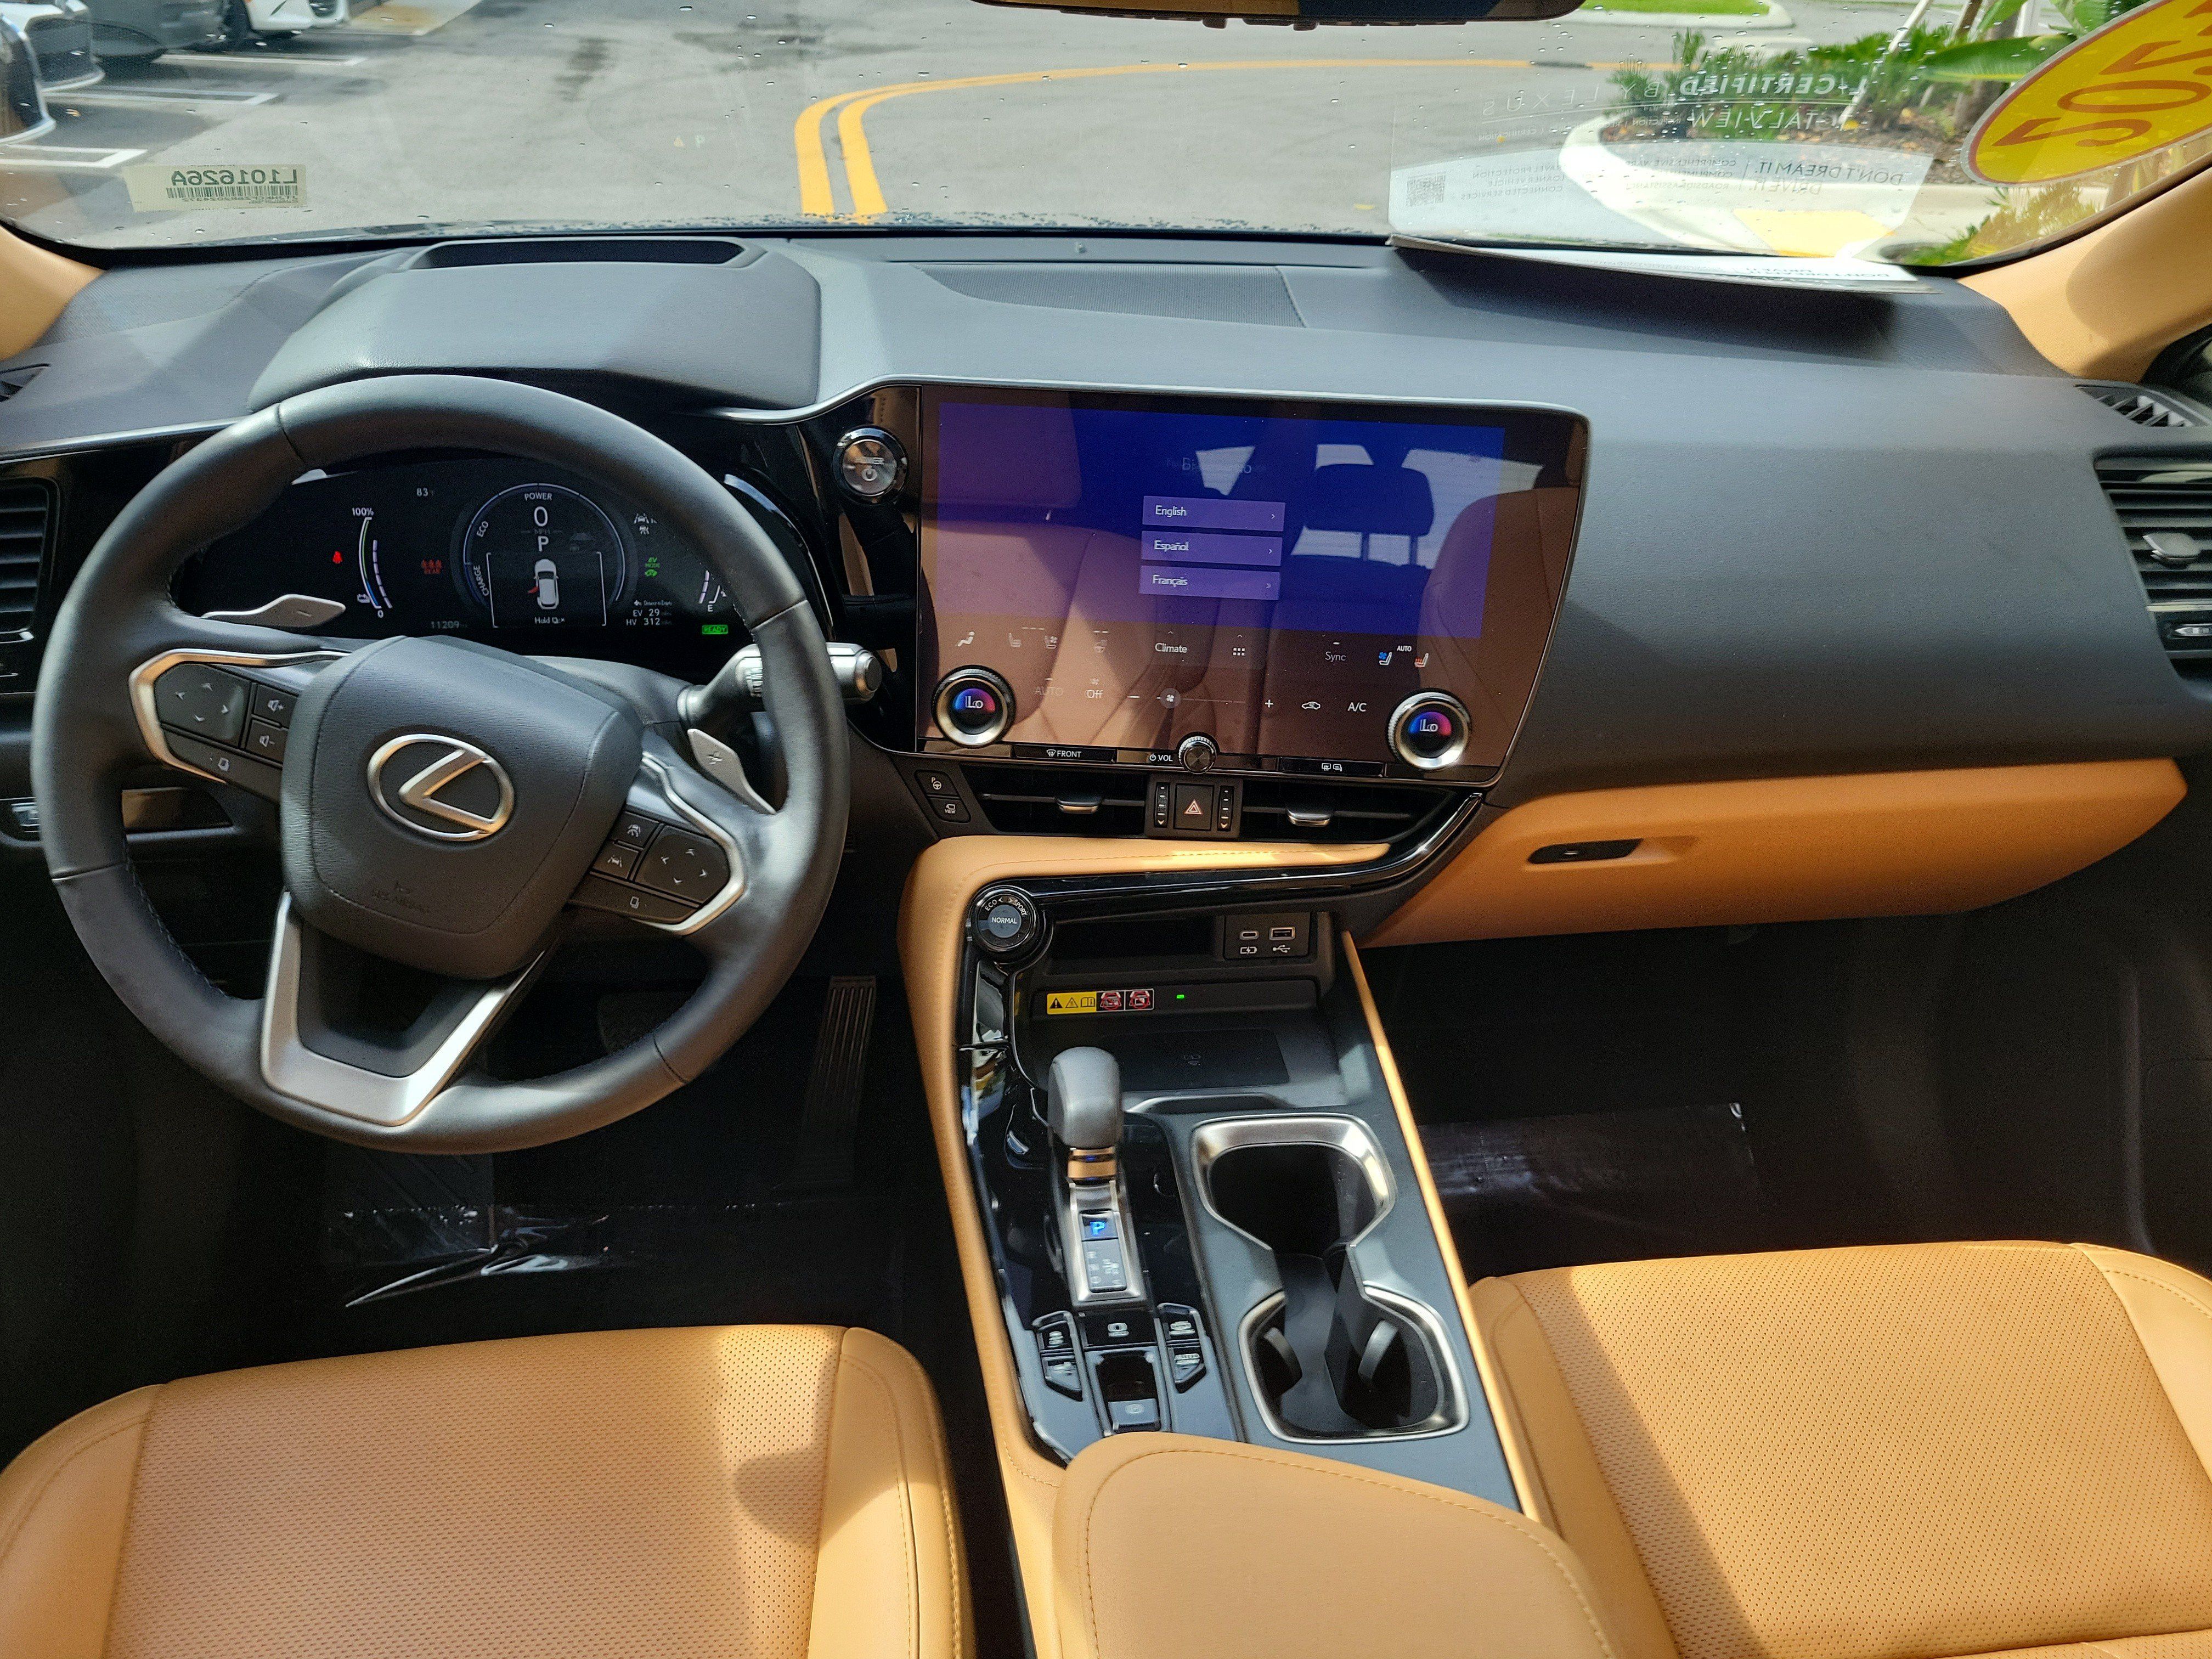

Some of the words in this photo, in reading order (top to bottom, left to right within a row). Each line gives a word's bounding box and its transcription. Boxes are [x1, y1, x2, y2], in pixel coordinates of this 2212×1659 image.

[524, 492, 552, 501] POWER
[352, 507, 374, 517] 100%
[534, 506, 548, 527] 0
[1155, 505, 1187, 517] English
[476, 521, 489, 538] ECO
[538, 535, 549, 552] P
[1154, 539, 1189, 552] Español
[472, 564, 489, 597] CHARGE
[1152, 574, 1188, 587] Français
[633, 609, 643, 617] EV
[648, 608, 660, 617] 29
[626, 618, 637, 627] HV
[644, 618, 661, 626] 312
[1155, 642, 1188, 653] Climate
[1324, 651, 1346, 662] Sync
[1086, 689, 1104, 699] Off
[1347, 702, 1367, 712] A/C
[1057, 751, 1082, 759] FRONT
[984, 899, 997, 911] ECO
[1014, 899, 1027, 916] SPORT
[1090, 1221, 1106, 1235] P
